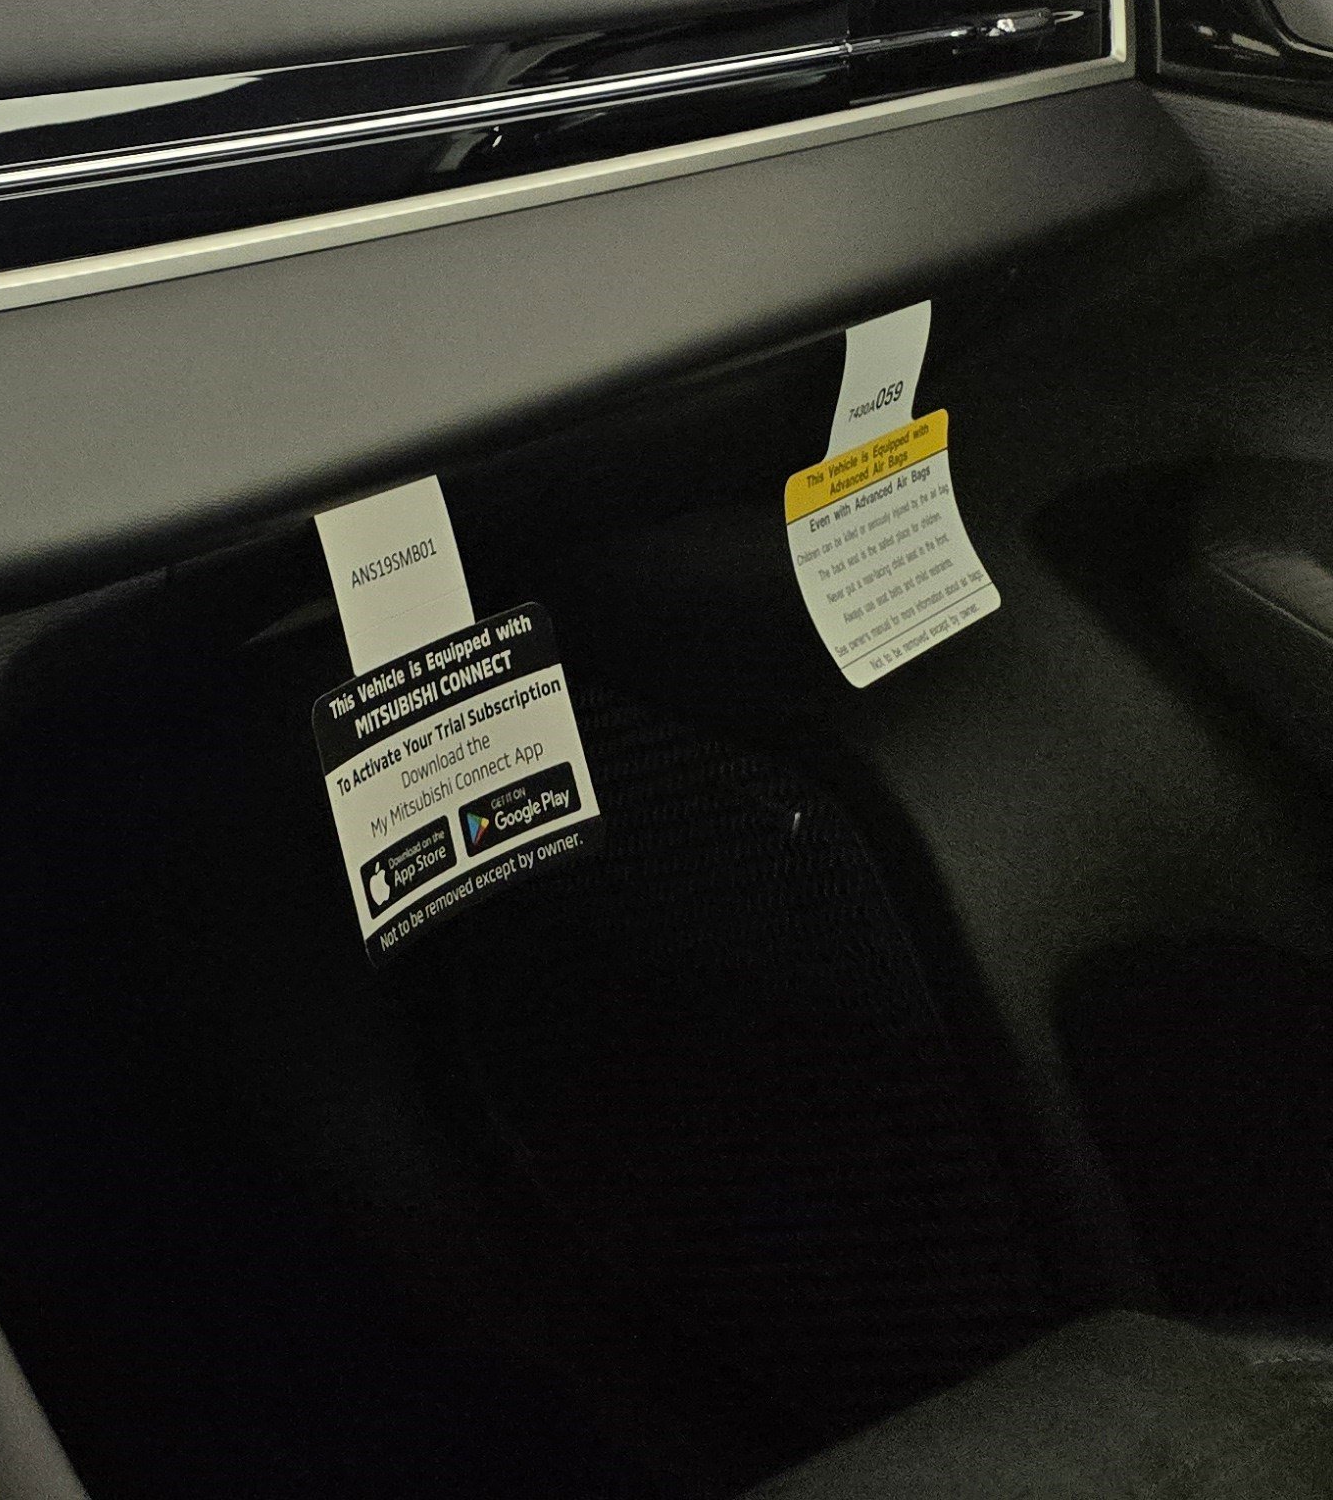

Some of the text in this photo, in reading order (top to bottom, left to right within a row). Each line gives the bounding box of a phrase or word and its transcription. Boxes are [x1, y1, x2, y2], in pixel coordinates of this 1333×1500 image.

[806, 471, 825, 488] This
[828, 457, 858, 479] Vehicle
[872, 432, 910, 458] Equipped
[912, 423, 930, 440] with
[829, 450, 909, 496] Advanced Air Bags
[809, 466, 931, 533] Even with Advanced Air Bags
[351, 537, 437, 590] ANS19SMB01
[329, 614, 533, 720] This Vehicle is Equipped with
[354, 649, 512, 739] MITSUBISHI CONNECT
[336, 678, 562, 797] To Activate Your Trial Subscription
[401, 733, 492, 789] Download the
[370, 740, 545, 838] My Mitsubishi Connect App
[490, 792, 507, 810] GET
[513, 786, 527, 802] ON
[494, 787, 571, 831] Google Play
[387, 829, 446, 871] Download on the
[393, 845, 447, 888] App Store
[379, 830, 585, 952] Not to be removed except by owner.
